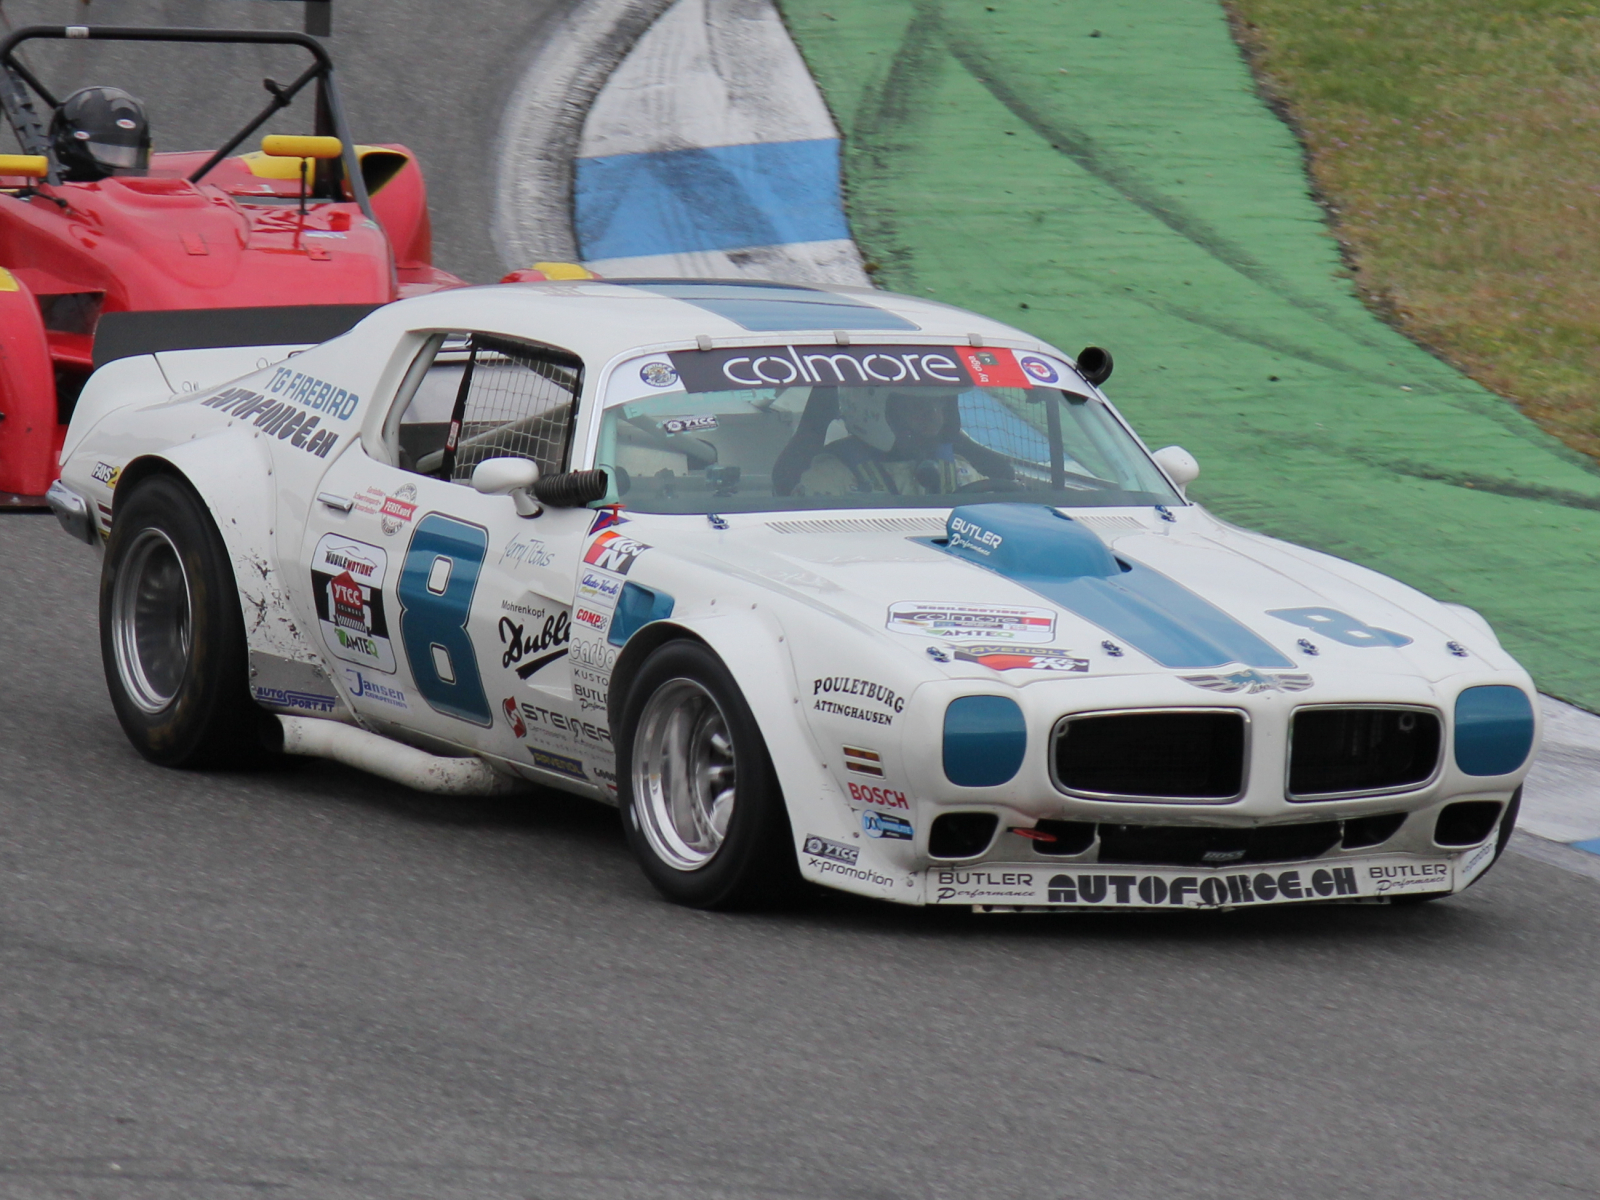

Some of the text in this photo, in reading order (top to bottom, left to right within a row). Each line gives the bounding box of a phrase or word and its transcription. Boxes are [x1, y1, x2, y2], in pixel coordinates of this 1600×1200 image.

[722, 344, 960, 384] colmore
[265, 367, 359, 421] TG FIREBIRD
[201, 387, 339, 459] AUTOFORCE.CH
[951, 517, 1003, 549] BUTLER
[333, 582, 361, 605] YTCC
[396, 510, 494, 731] 8
[502, 600, 546, 619] Mohrenkopf
[576, 608, 601, 625] COMP
[1264, 606, 1414, 649] 8
[346, 668, 405, 701] Jansen
[813, 677, 905, 714] POULETBURG
[813, 699, 894, 726] ATTINGHAUSEN
[847, 781, 910, 810] BOSCH
[808, 857, 895, 887] x-promotion
[938, 872, 1034, 885] BUTLER
[1047, 867, 1359, 905] AUTOFORCE.CH
[1371, 864, 1448, 878] BUTLER
[937, 886, 1035, 904] Performance
